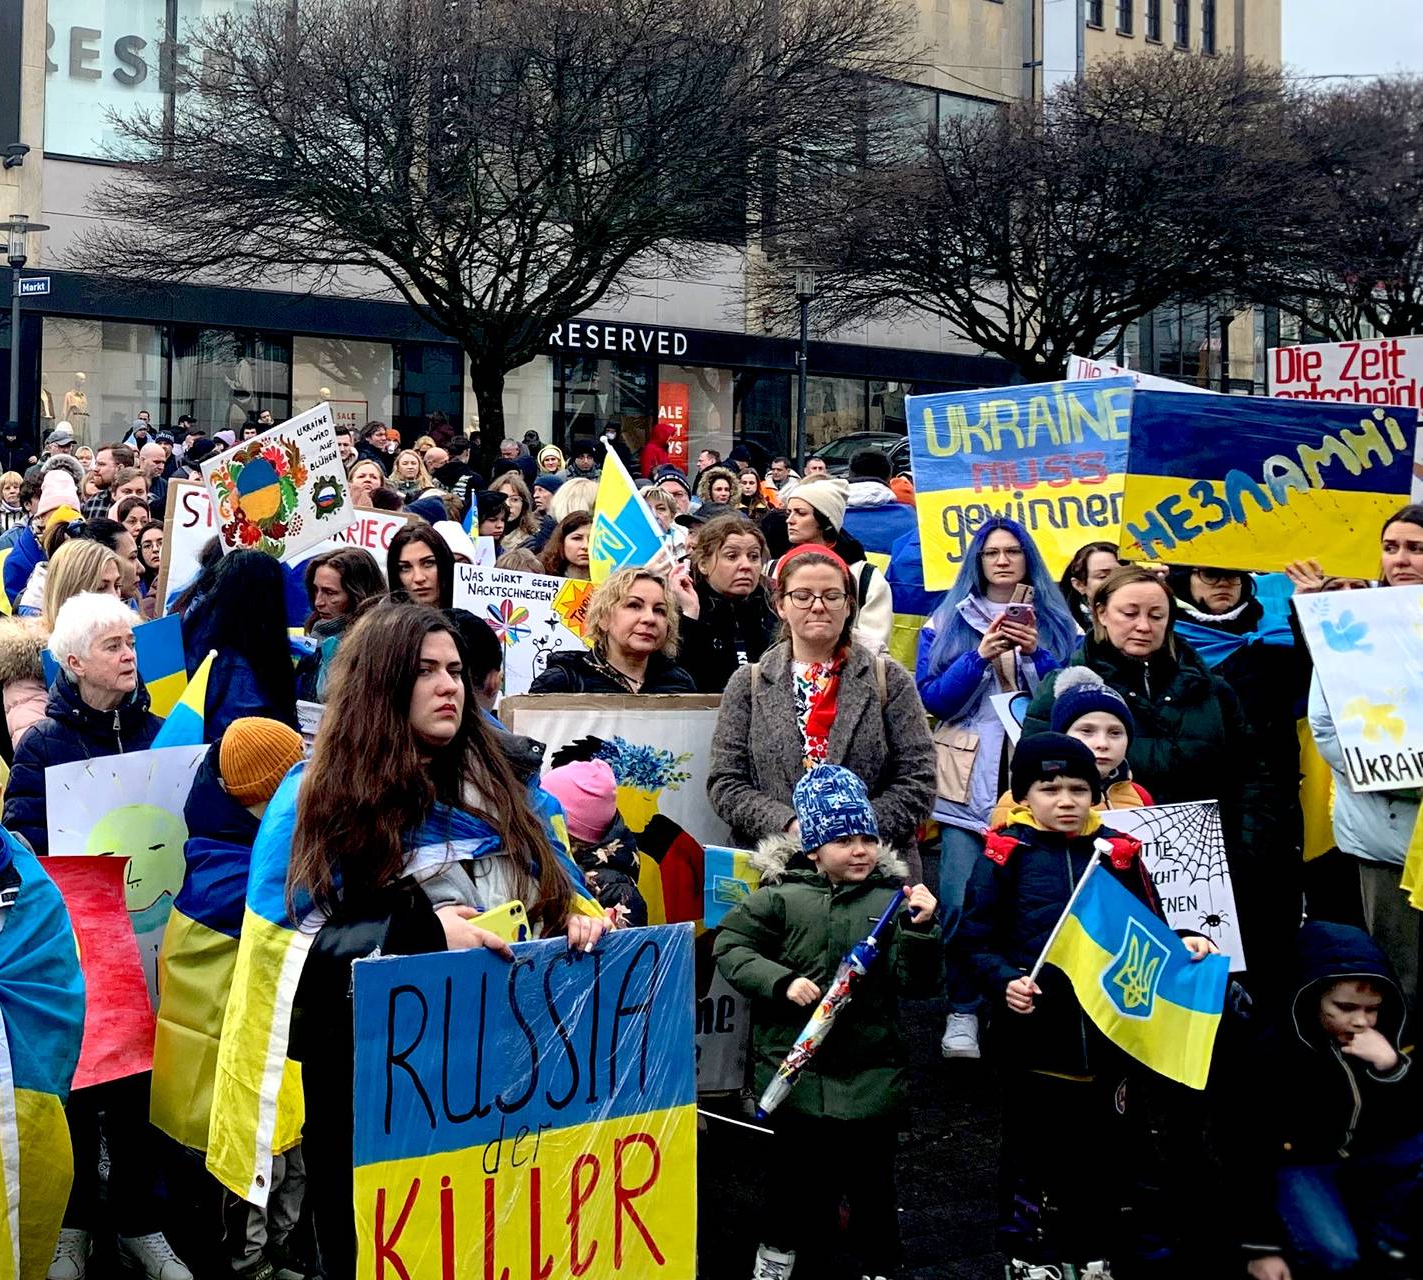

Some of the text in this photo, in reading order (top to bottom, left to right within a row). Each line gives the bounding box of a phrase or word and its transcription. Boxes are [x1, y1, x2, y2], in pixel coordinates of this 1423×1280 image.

[22, 282, 46, 292] Markt
[549, 323, 687, 355] RESERVED
[1275, 339, 1406, 384] Die Zeit
[337, 412, 356, 420] SALE
[658, 406, 683, 419] ALE
[310, 450, 337, 471] BLÜHEN
[532, 579, 559, 588] GEGEN
[384, 941, 661, 1135] RUSSIA
[482, 1116, 552, 1175] der
